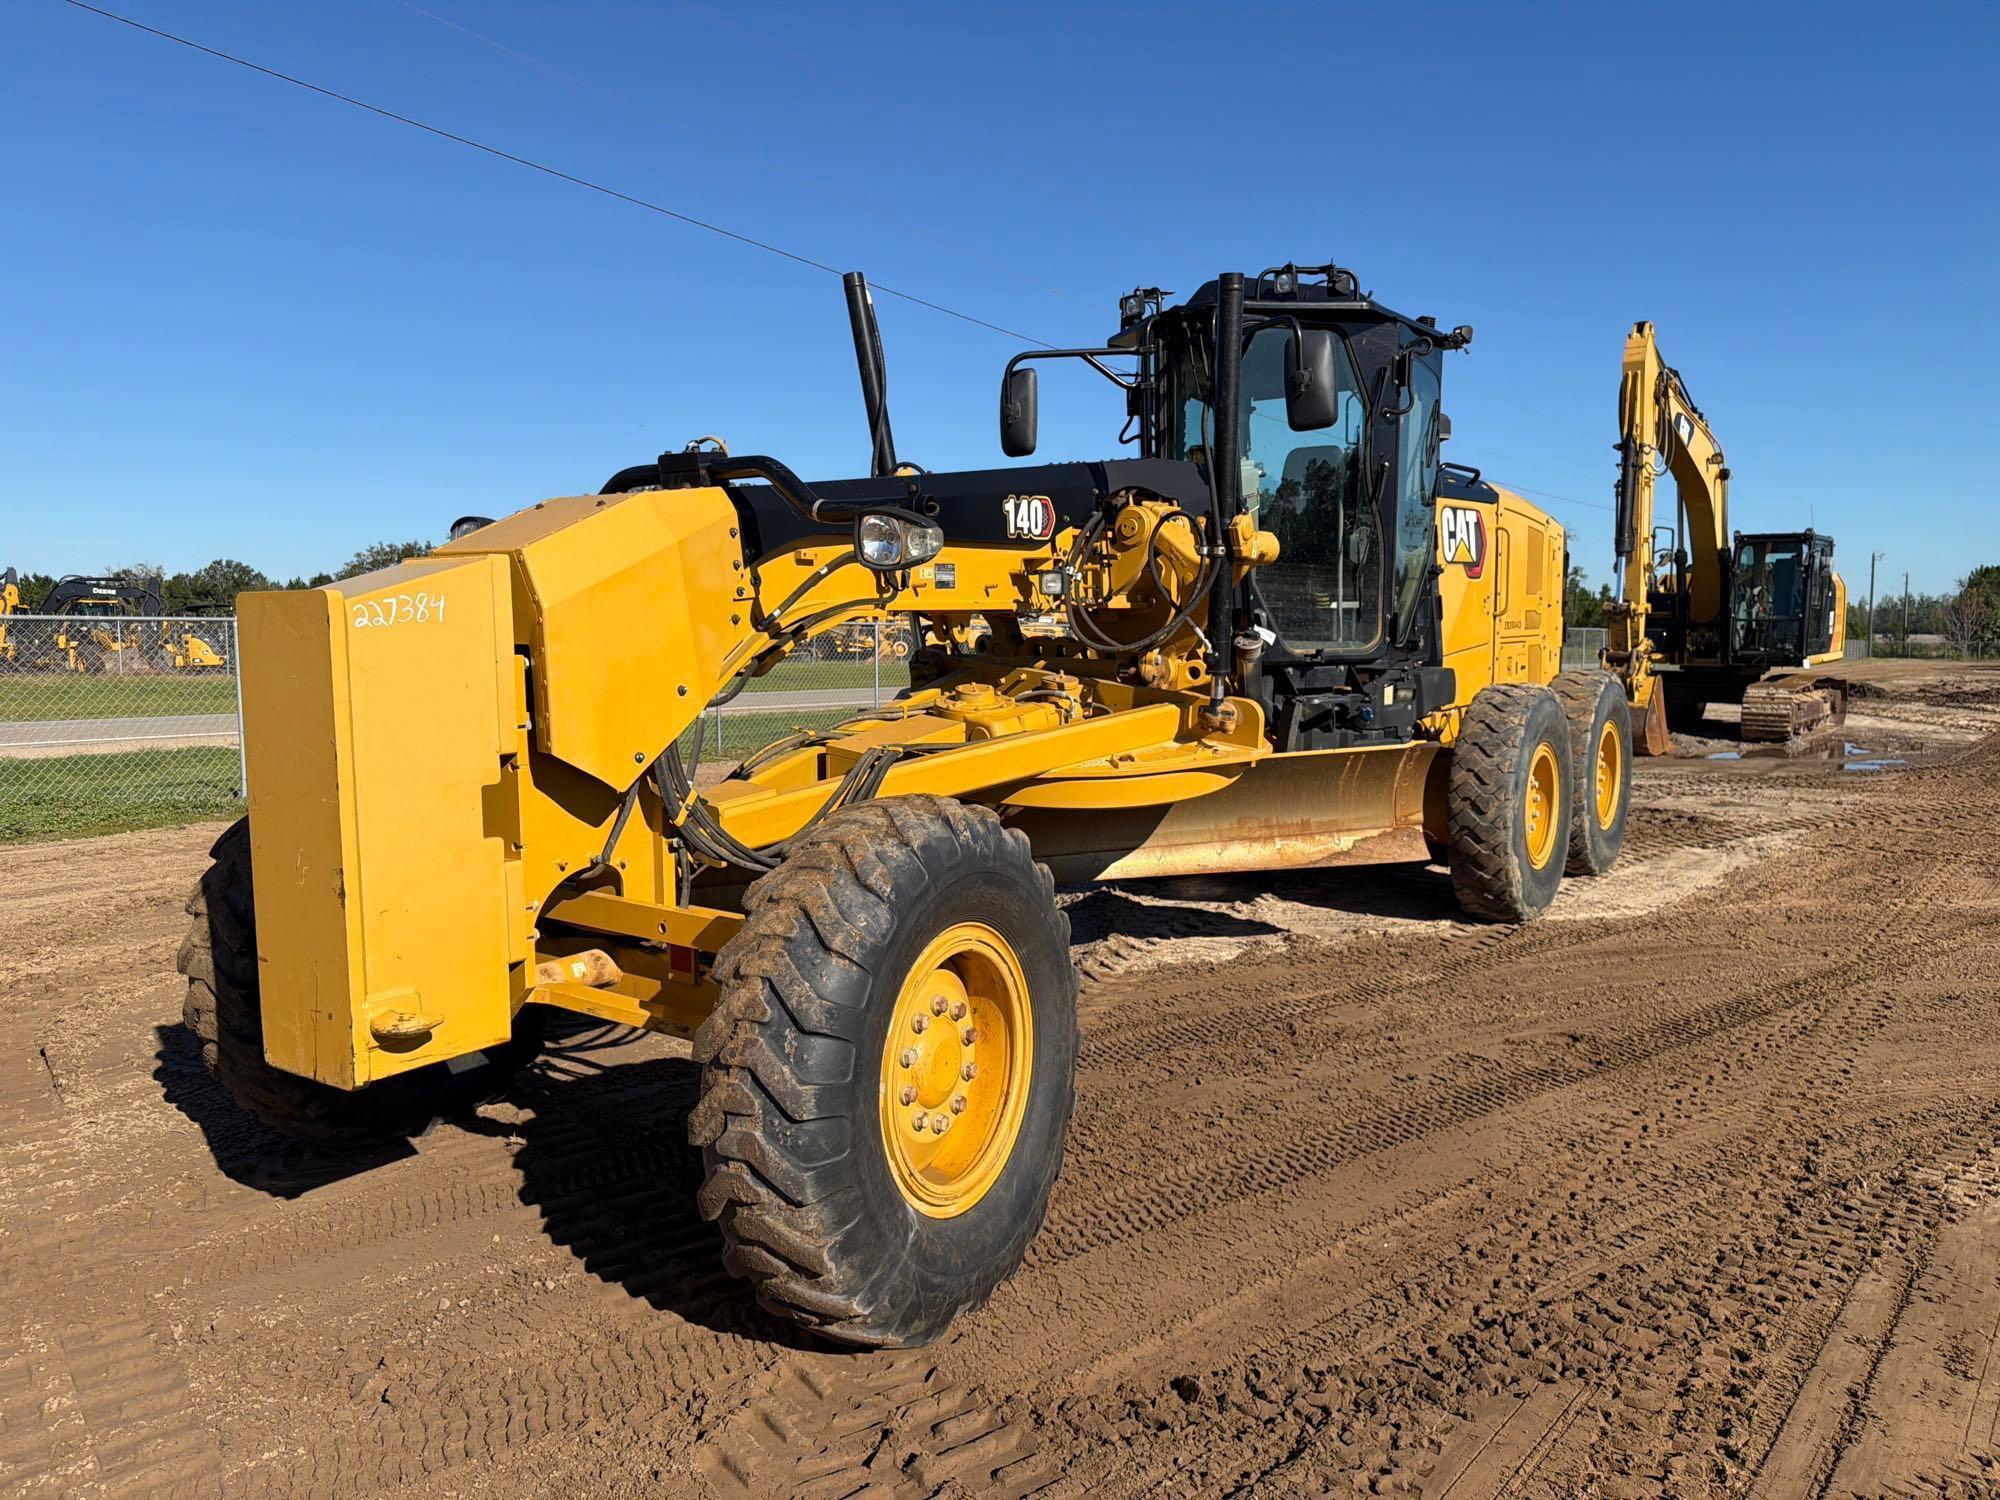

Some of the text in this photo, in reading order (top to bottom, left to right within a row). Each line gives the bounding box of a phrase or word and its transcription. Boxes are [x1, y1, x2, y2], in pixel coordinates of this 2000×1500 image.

[1004, 498, 1043, 536] 140
[1441, 506, 1478, 563] CAT
[353, 592, 445, 627] 227384
